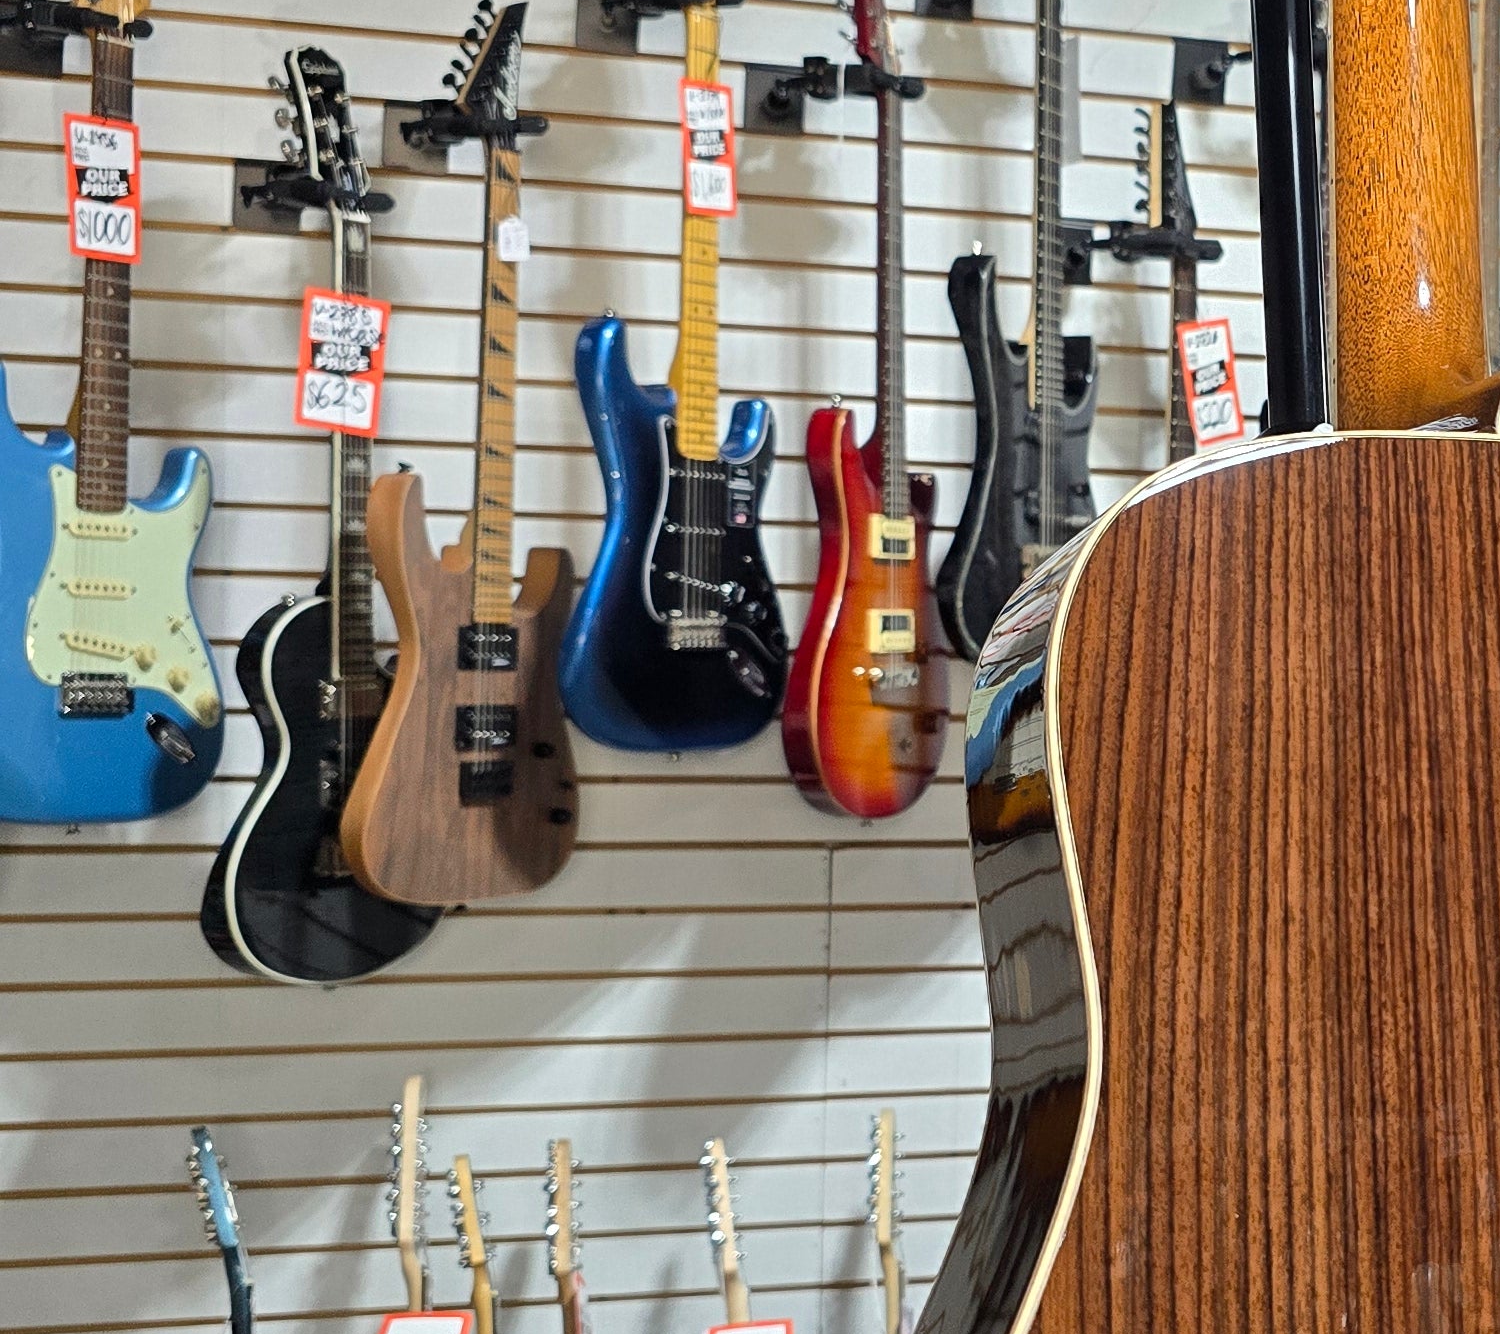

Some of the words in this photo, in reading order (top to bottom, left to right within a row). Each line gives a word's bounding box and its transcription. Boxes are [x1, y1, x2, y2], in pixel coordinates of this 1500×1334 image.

[84, 167, 121, 183] OUR
[80, 180, 129, 197] PRICE
[77, 207, 132, 246] $1000
[320, 342, 362, 358] OUR
[314, 353, 370, 372] PRICE
[306, 379, 368, 414] $625
